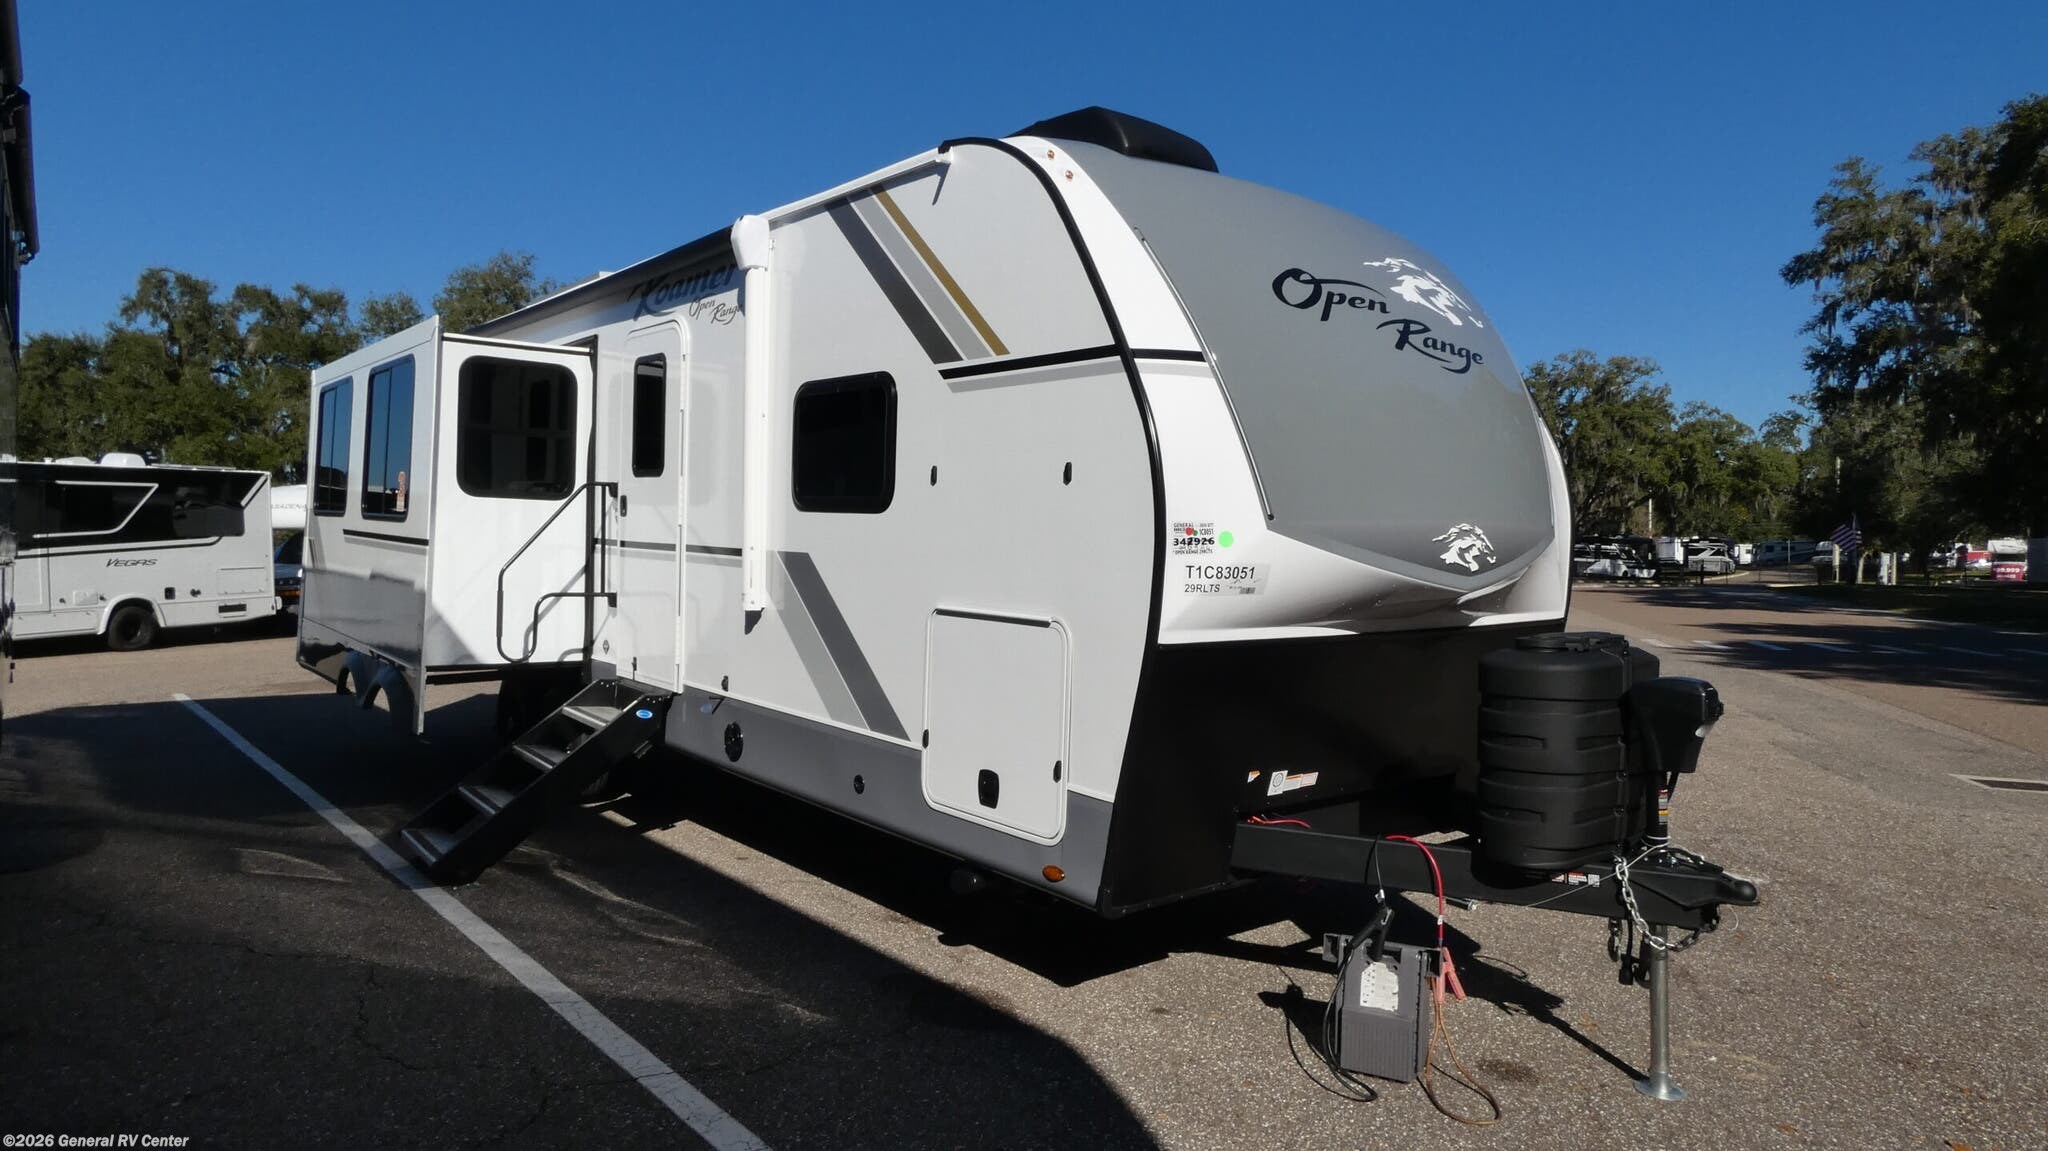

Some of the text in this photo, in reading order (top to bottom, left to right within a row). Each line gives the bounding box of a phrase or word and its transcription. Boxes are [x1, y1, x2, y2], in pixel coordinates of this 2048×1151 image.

[627, 263, 739, 321] Roamer
[1272, 267, 1391, 322] Open
[689, 296, 717, 320] Open
[1376, 318, 1485, 375] Range
[1173, 537, 1215, 546] 342926
[106, 558, 158, 568] VEGAS
[1186, 565, 1255, 579] T1C83051
[1184, 583, 1221, 593] 29RLTS
